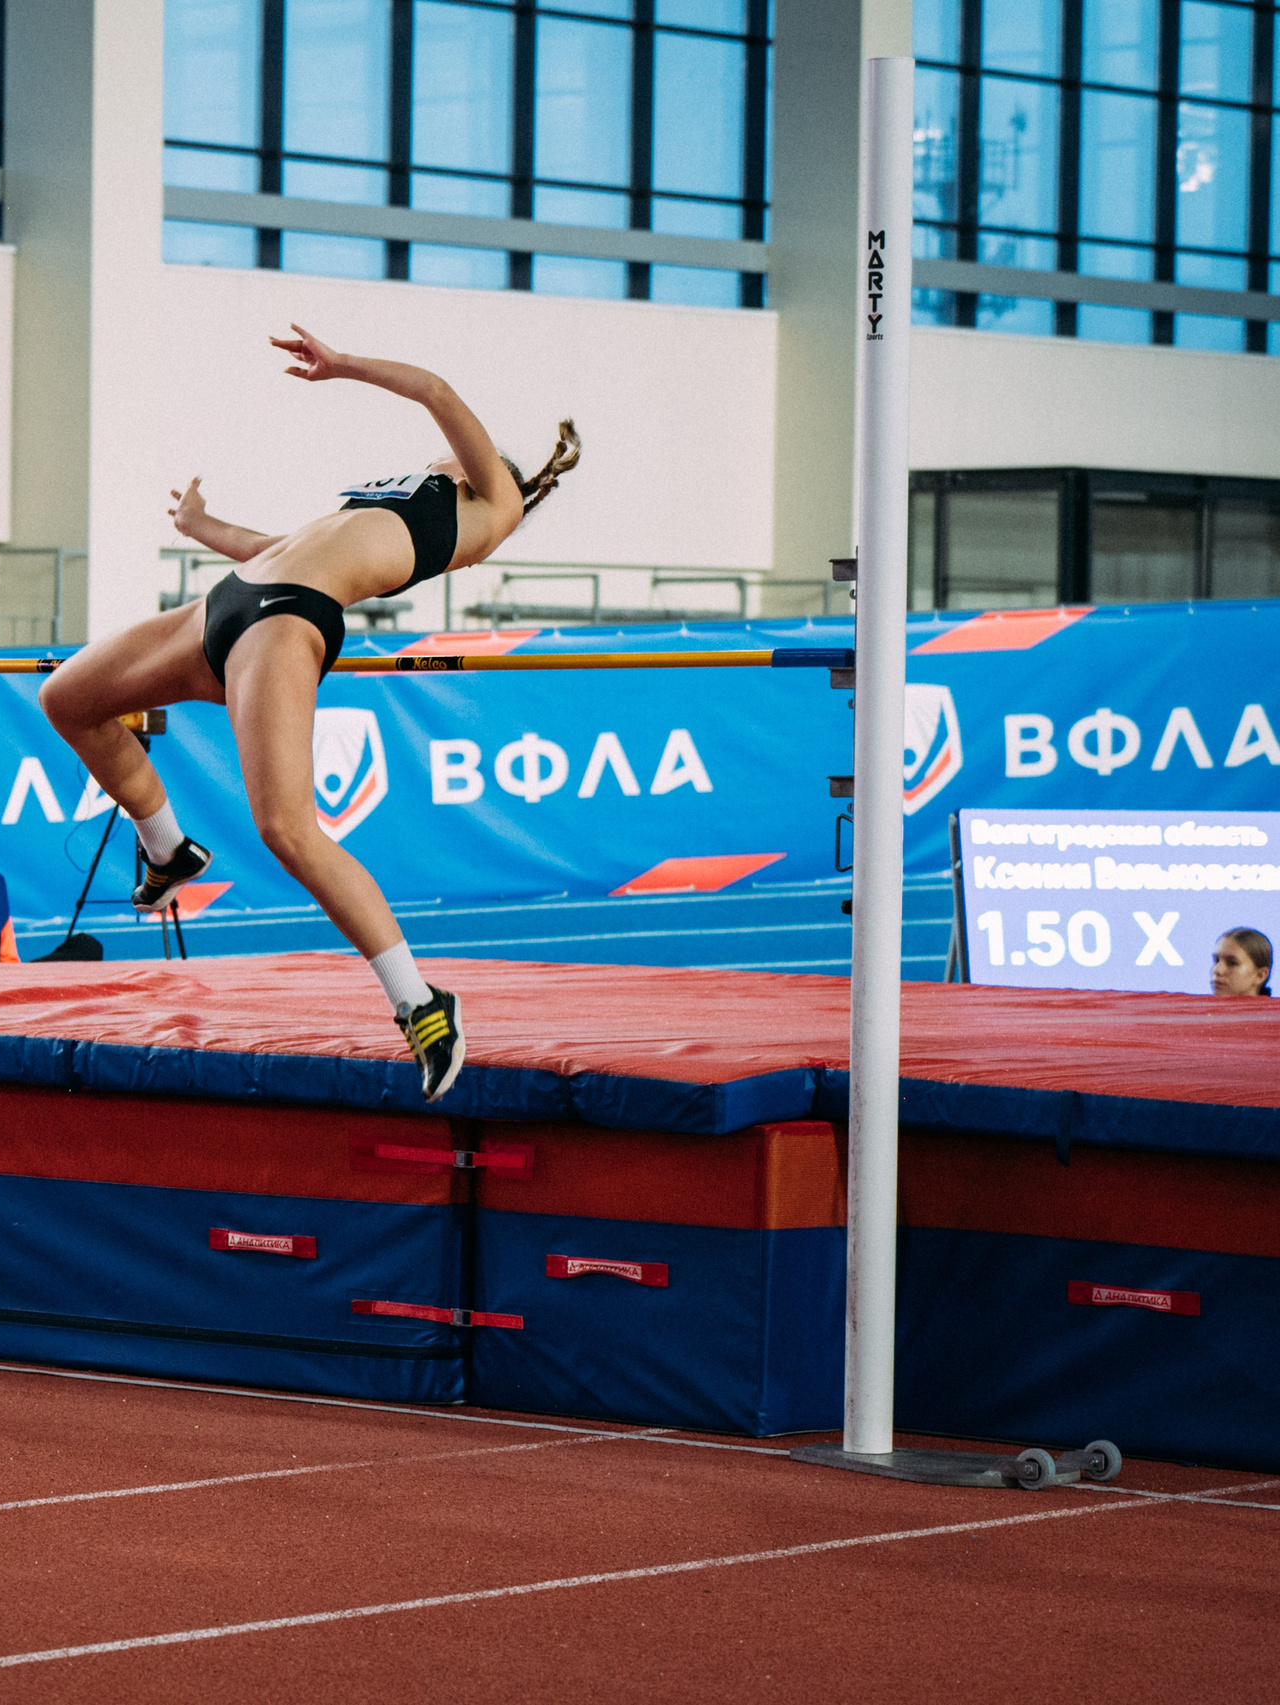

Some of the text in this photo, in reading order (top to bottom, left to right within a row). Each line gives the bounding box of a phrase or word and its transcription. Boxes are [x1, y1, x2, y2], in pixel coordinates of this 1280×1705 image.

[867, 229, 885, 334] MARTY
[429, 728, 714, 805] ВФЛА
[1004, 703, 1280, 778] ВФЛА
[970, 819, 1268, 851] Волгоградская область
[977, 910, 1112, 967] 1.50
